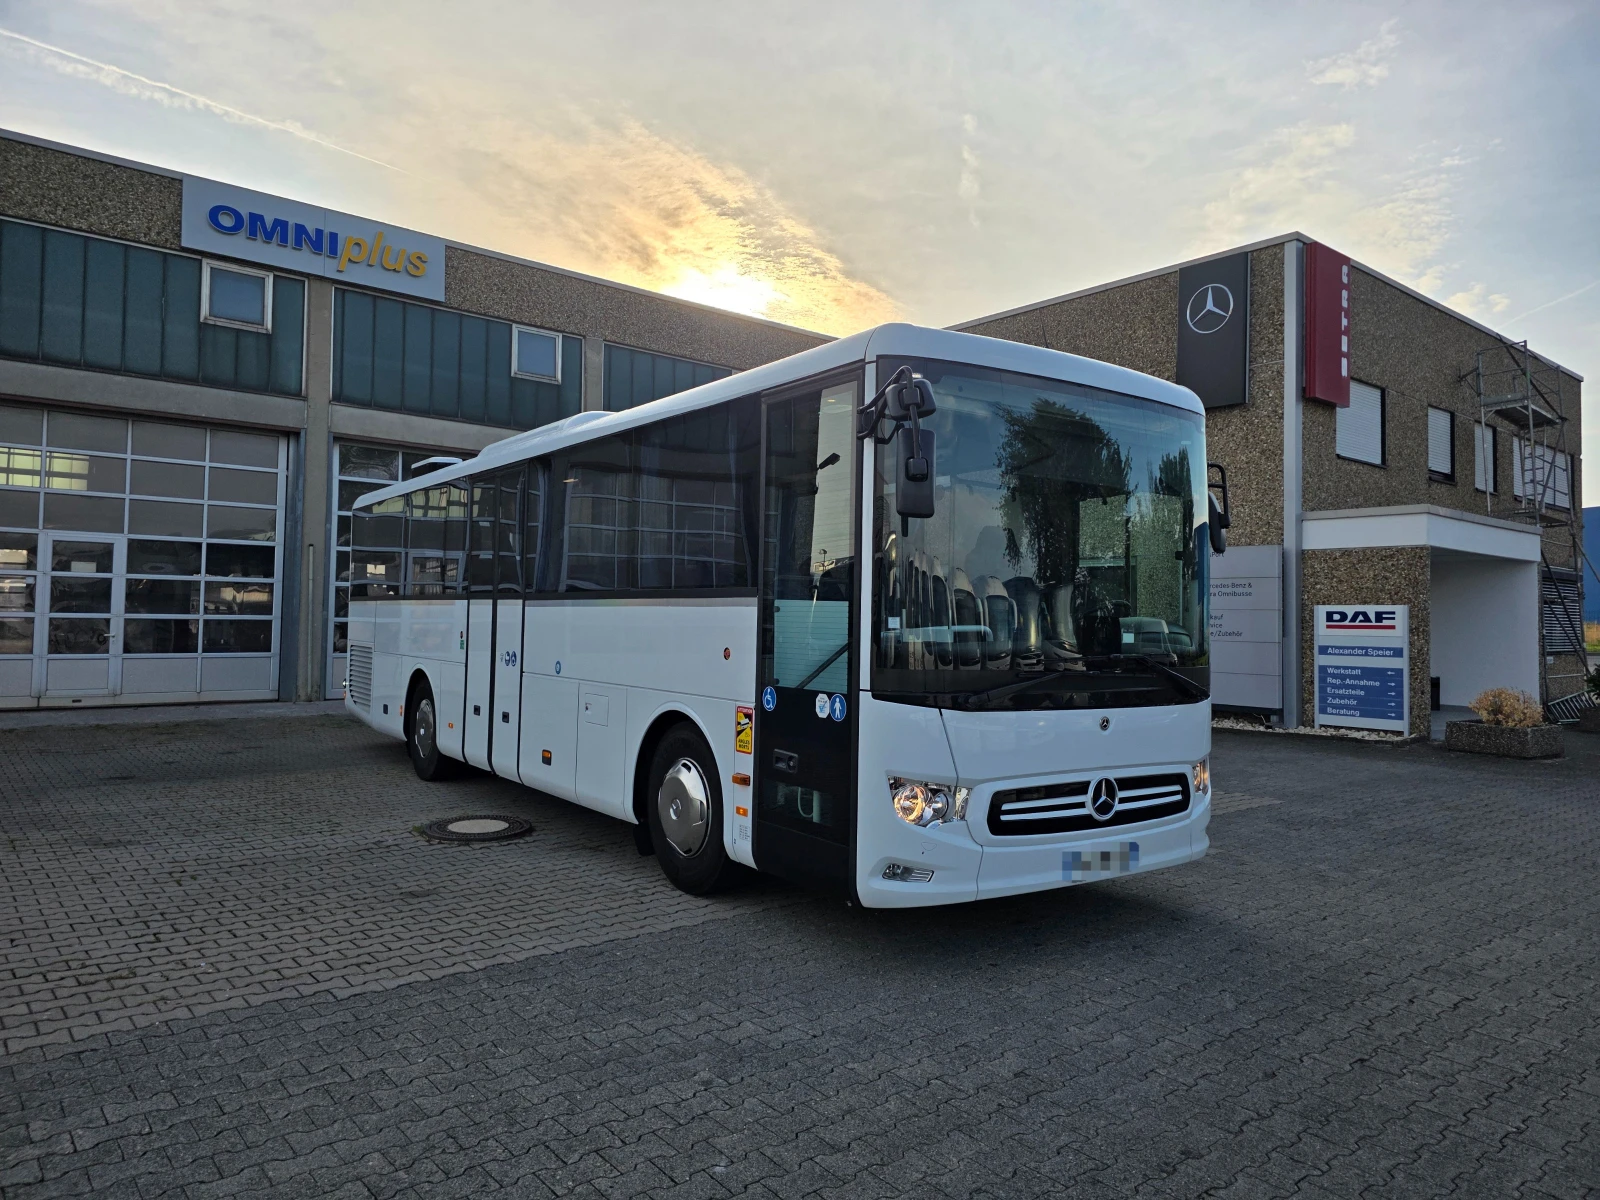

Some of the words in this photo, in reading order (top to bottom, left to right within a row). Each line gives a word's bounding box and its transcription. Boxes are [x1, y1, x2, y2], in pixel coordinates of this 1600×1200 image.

[207, 204, 429, 277] OMNIplus
[1326, 610, 1396, 624] DAF
[1327, 647, 1366, 656] Alexander
[1367, 648, 1394, 657] Speier
[1327, 677, 1380, 686] Rep.-Annahme
[1327, 687, 1365, 696] Ersatzteile
[1327, 697, 1357, 705] Zubehör
[1327, 707, 1360, 716] Beratung
